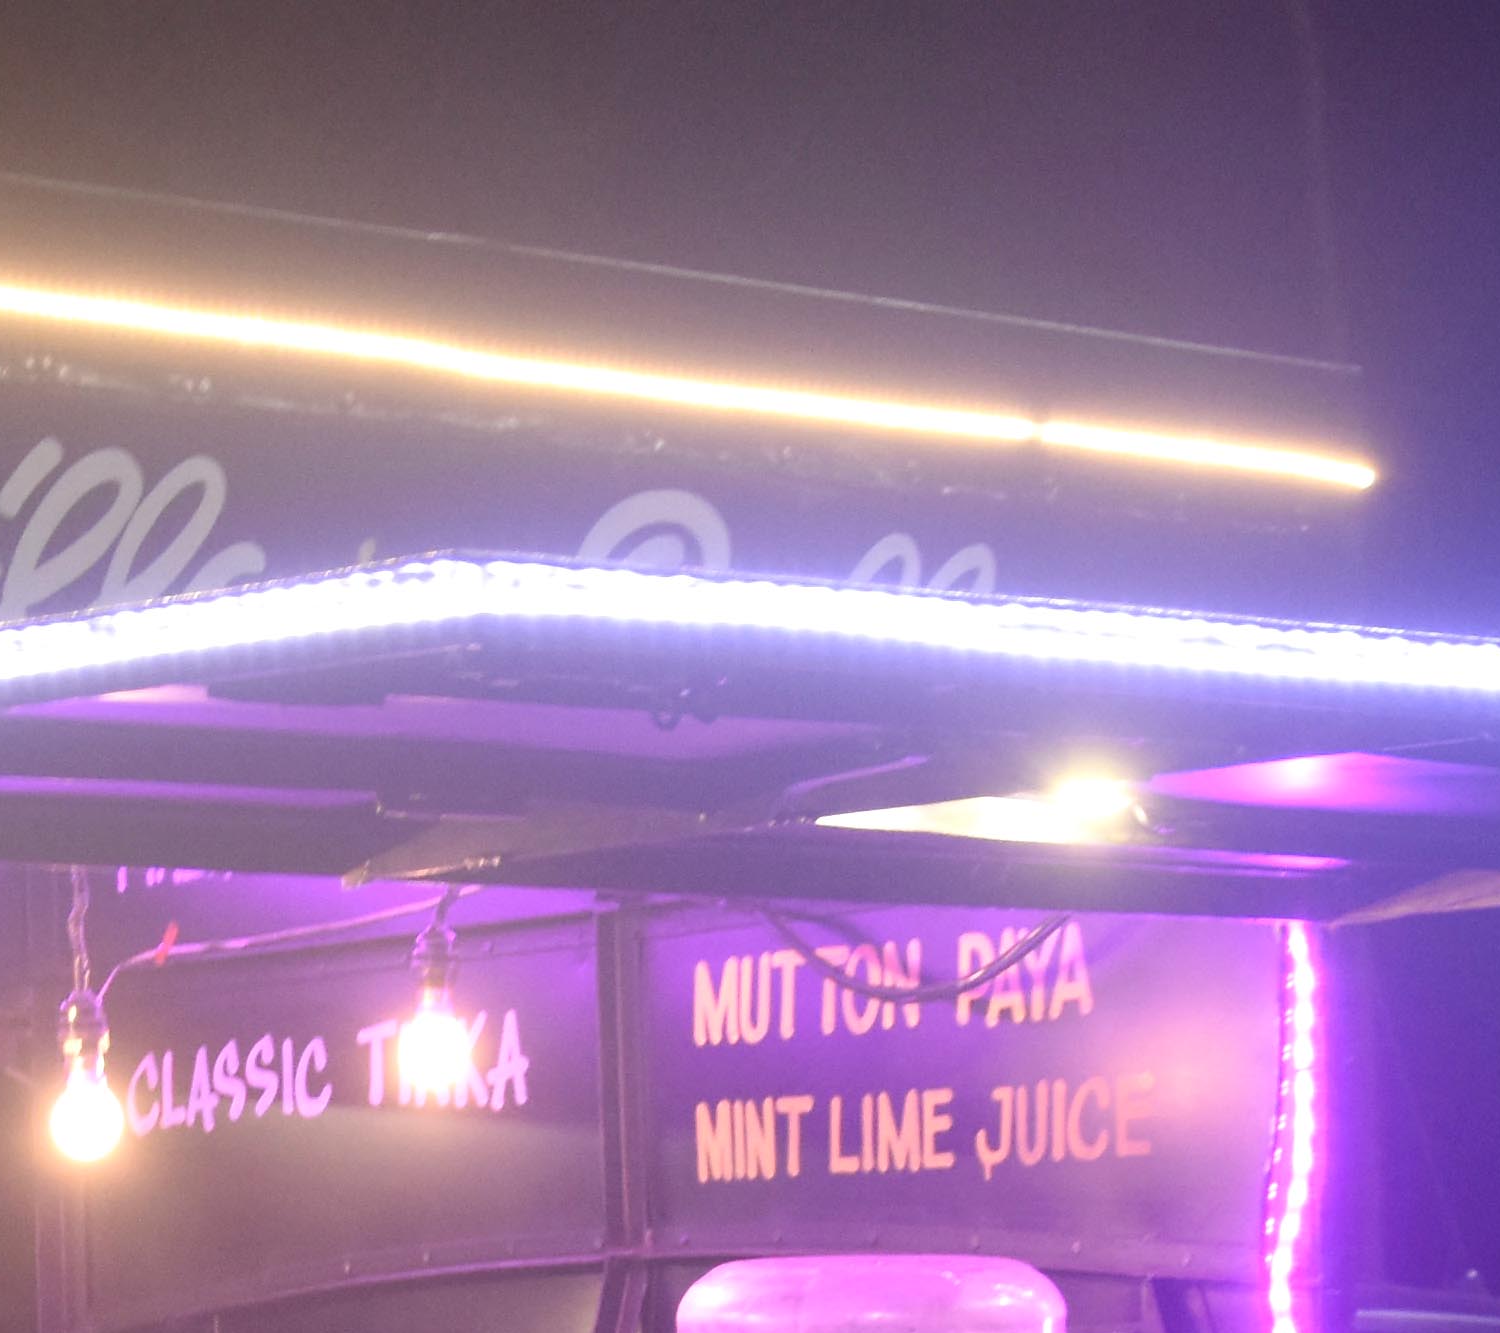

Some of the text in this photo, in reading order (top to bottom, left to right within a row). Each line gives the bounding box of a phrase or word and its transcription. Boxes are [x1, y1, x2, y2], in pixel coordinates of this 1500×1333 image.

[955, 920, 1094, 1029] PAYA
[127, 1008, 530, 1135] CLASSIC TKA
[694, 1072, 1156, 1184] MINT LIME JUICE
